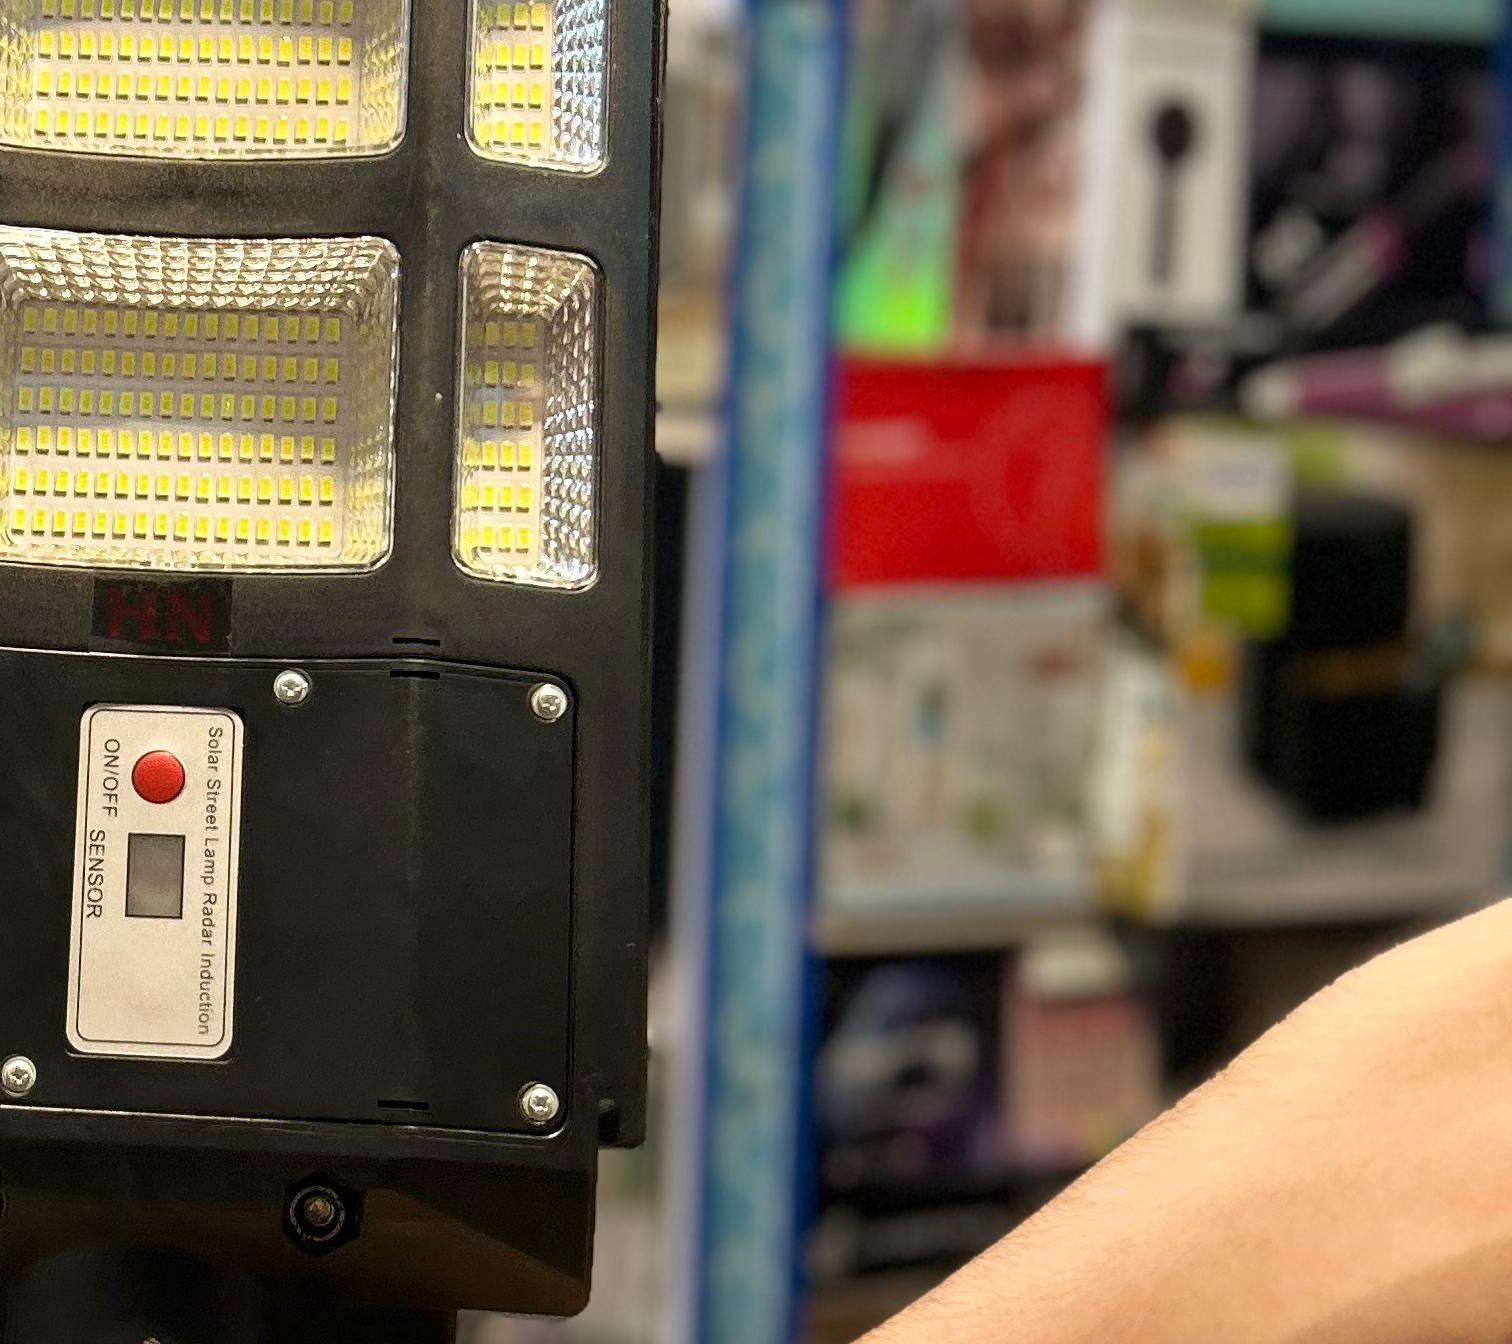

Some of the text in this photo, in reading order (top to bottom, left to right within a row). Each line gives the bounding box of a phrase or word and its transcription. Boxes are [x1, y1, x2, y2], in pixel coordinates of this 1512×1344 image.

[108, 587, 212, 643] HN
[103, 738, 120, 818] ON/OFF
[86, 828, 106, 918] SENSOR
[198, 726, 223, 1035] Solar Street Lamp Radar Induction
